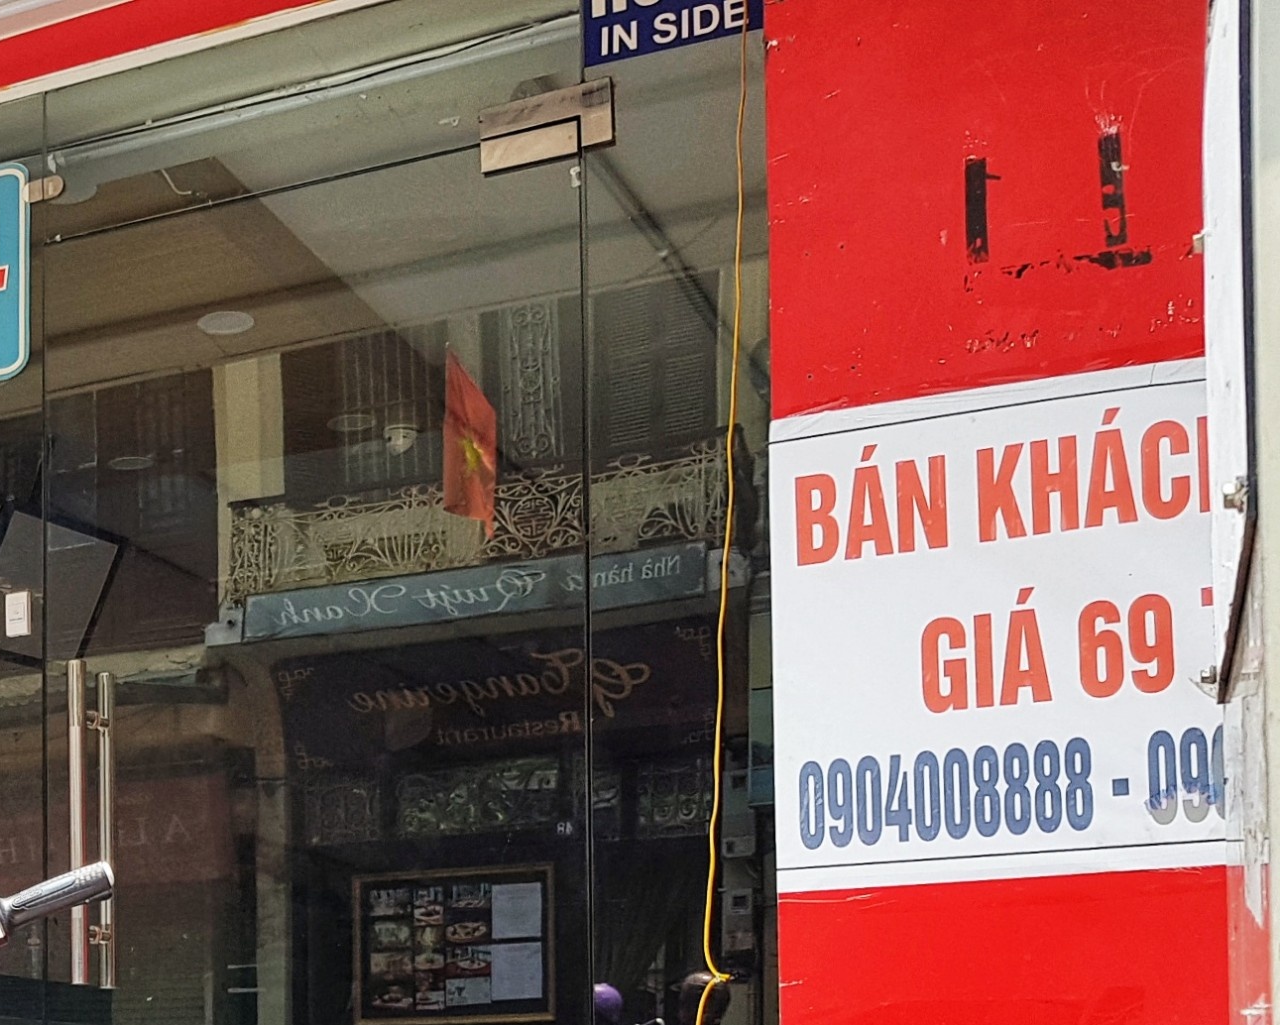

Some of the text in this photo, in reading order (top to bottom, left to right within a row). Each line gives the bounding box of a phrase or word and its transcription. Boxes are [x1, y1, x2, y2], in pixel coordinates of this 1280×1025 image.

[601, 20, 638, 57] IN
[652, 0, 749, 44] SIDE
[794, 408, 1211, 567] BÁN KHÁC
[921, 586, 1175, 714] GIÁ 69
[798, 737, 1094, 851] 0904008888
